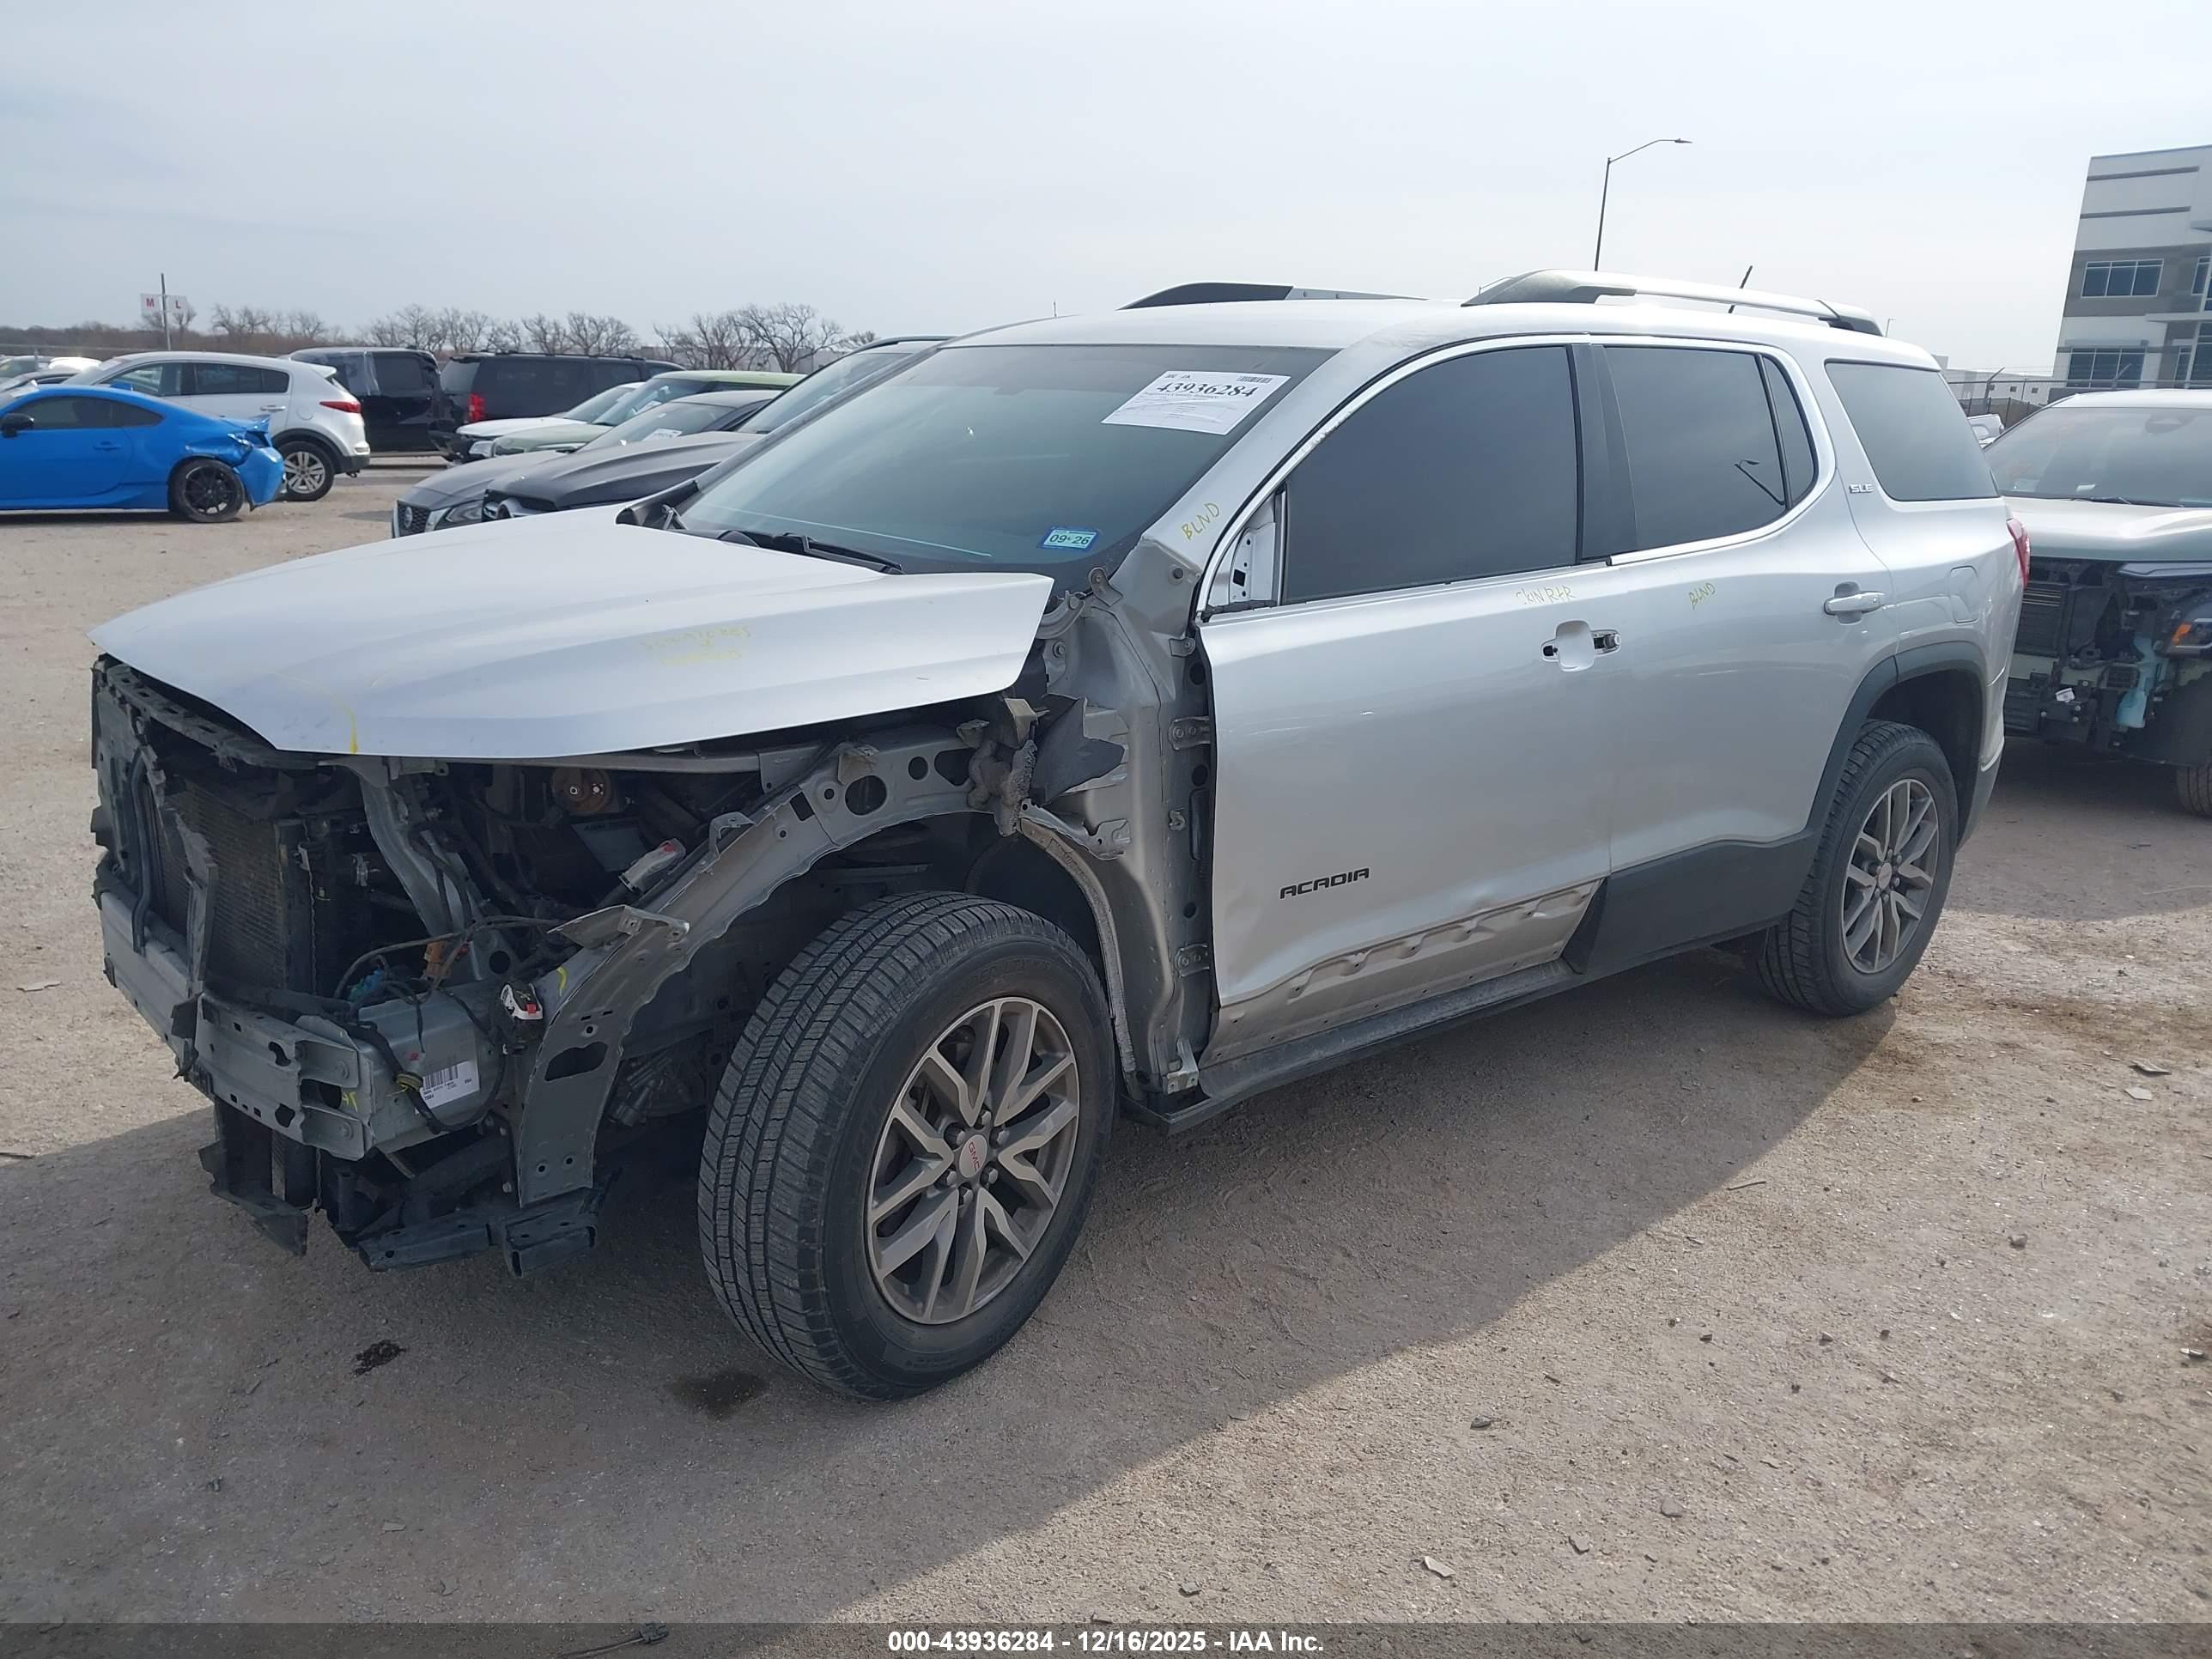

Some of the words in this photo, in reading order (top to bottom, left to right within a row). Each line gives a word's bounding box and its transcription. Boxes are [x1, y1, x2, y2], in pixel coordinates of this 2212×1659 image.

[146, 298, 155, 307] M
[1157, 380, 1259, 398] 43936284
[1849, 483, 1874, 494] SLE
[1049, 534, 1067, 543] 09
[1072, 536, 1091, 544] 26
[1279, 867, 1370, 899] ACADIA
[969, 1141, 981, 1172] GMC
